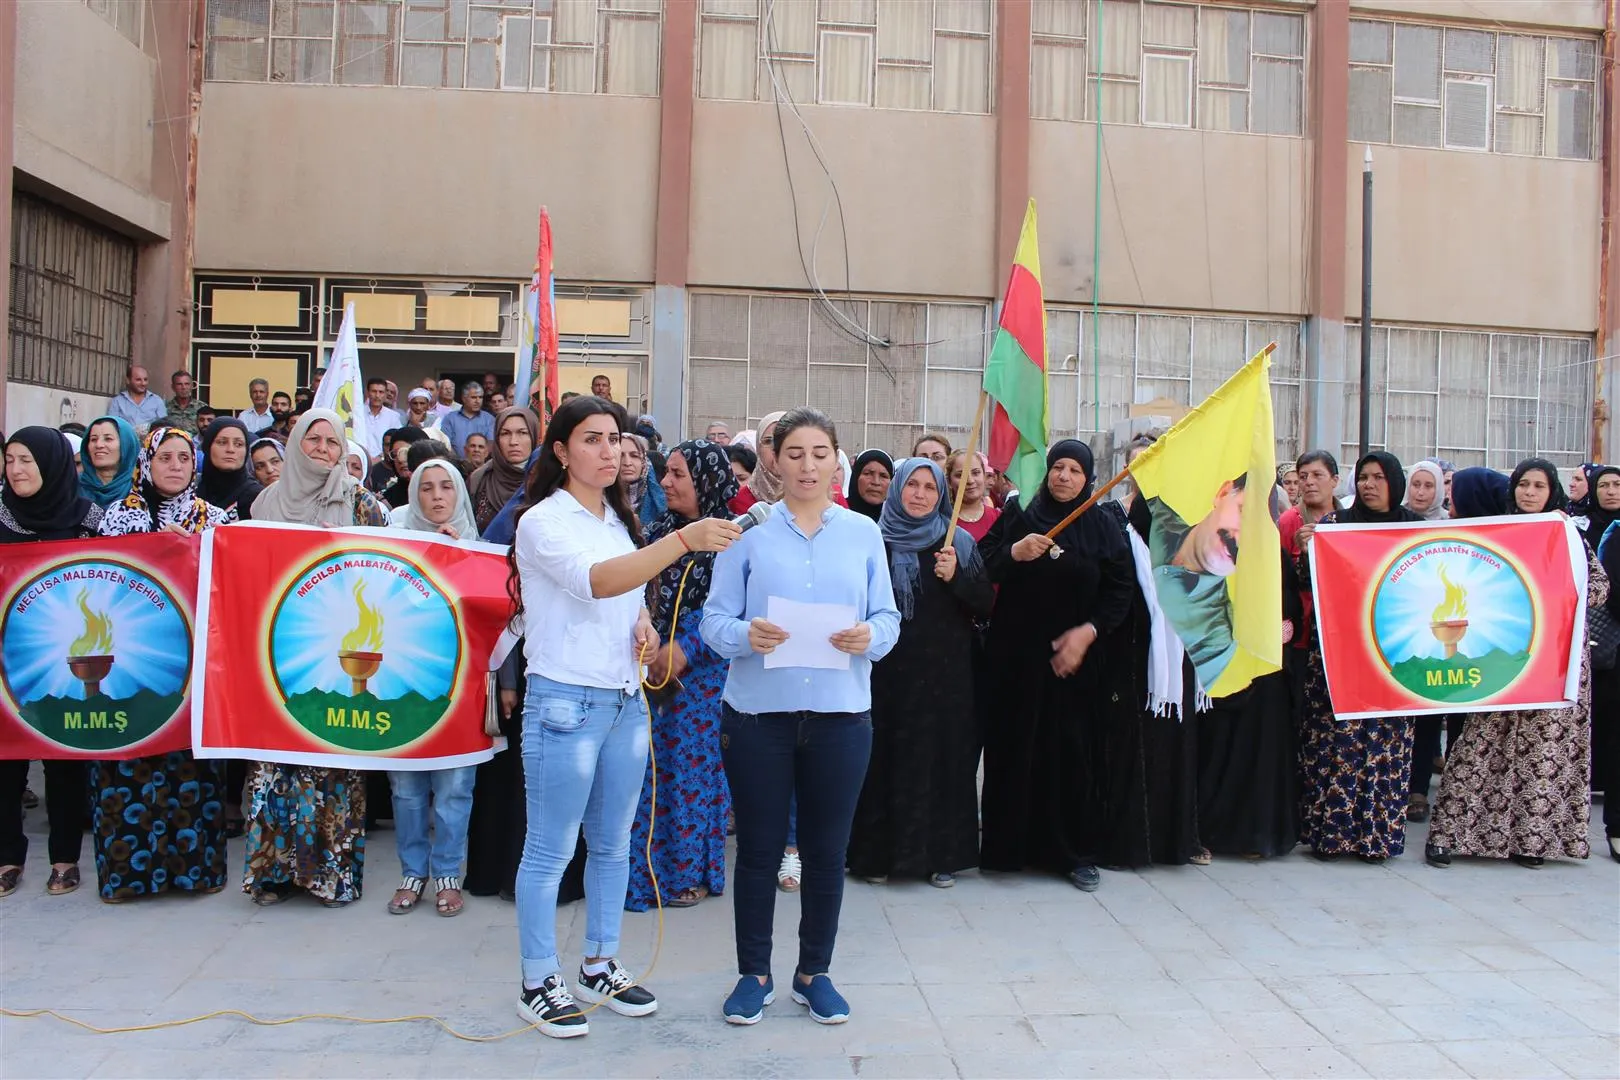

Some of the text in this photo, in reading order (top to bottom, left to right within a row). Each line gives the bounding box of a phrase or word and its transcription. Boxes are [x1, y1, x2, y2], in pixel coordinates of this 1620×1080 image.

[63, 569, 127, 585] MALBATÊN
[1426, 667, 1482, 688] M.M.Ş
[64, 710, 128, 733] M.M.Ş
[326, 707, 391, 735] M.M.Ş
